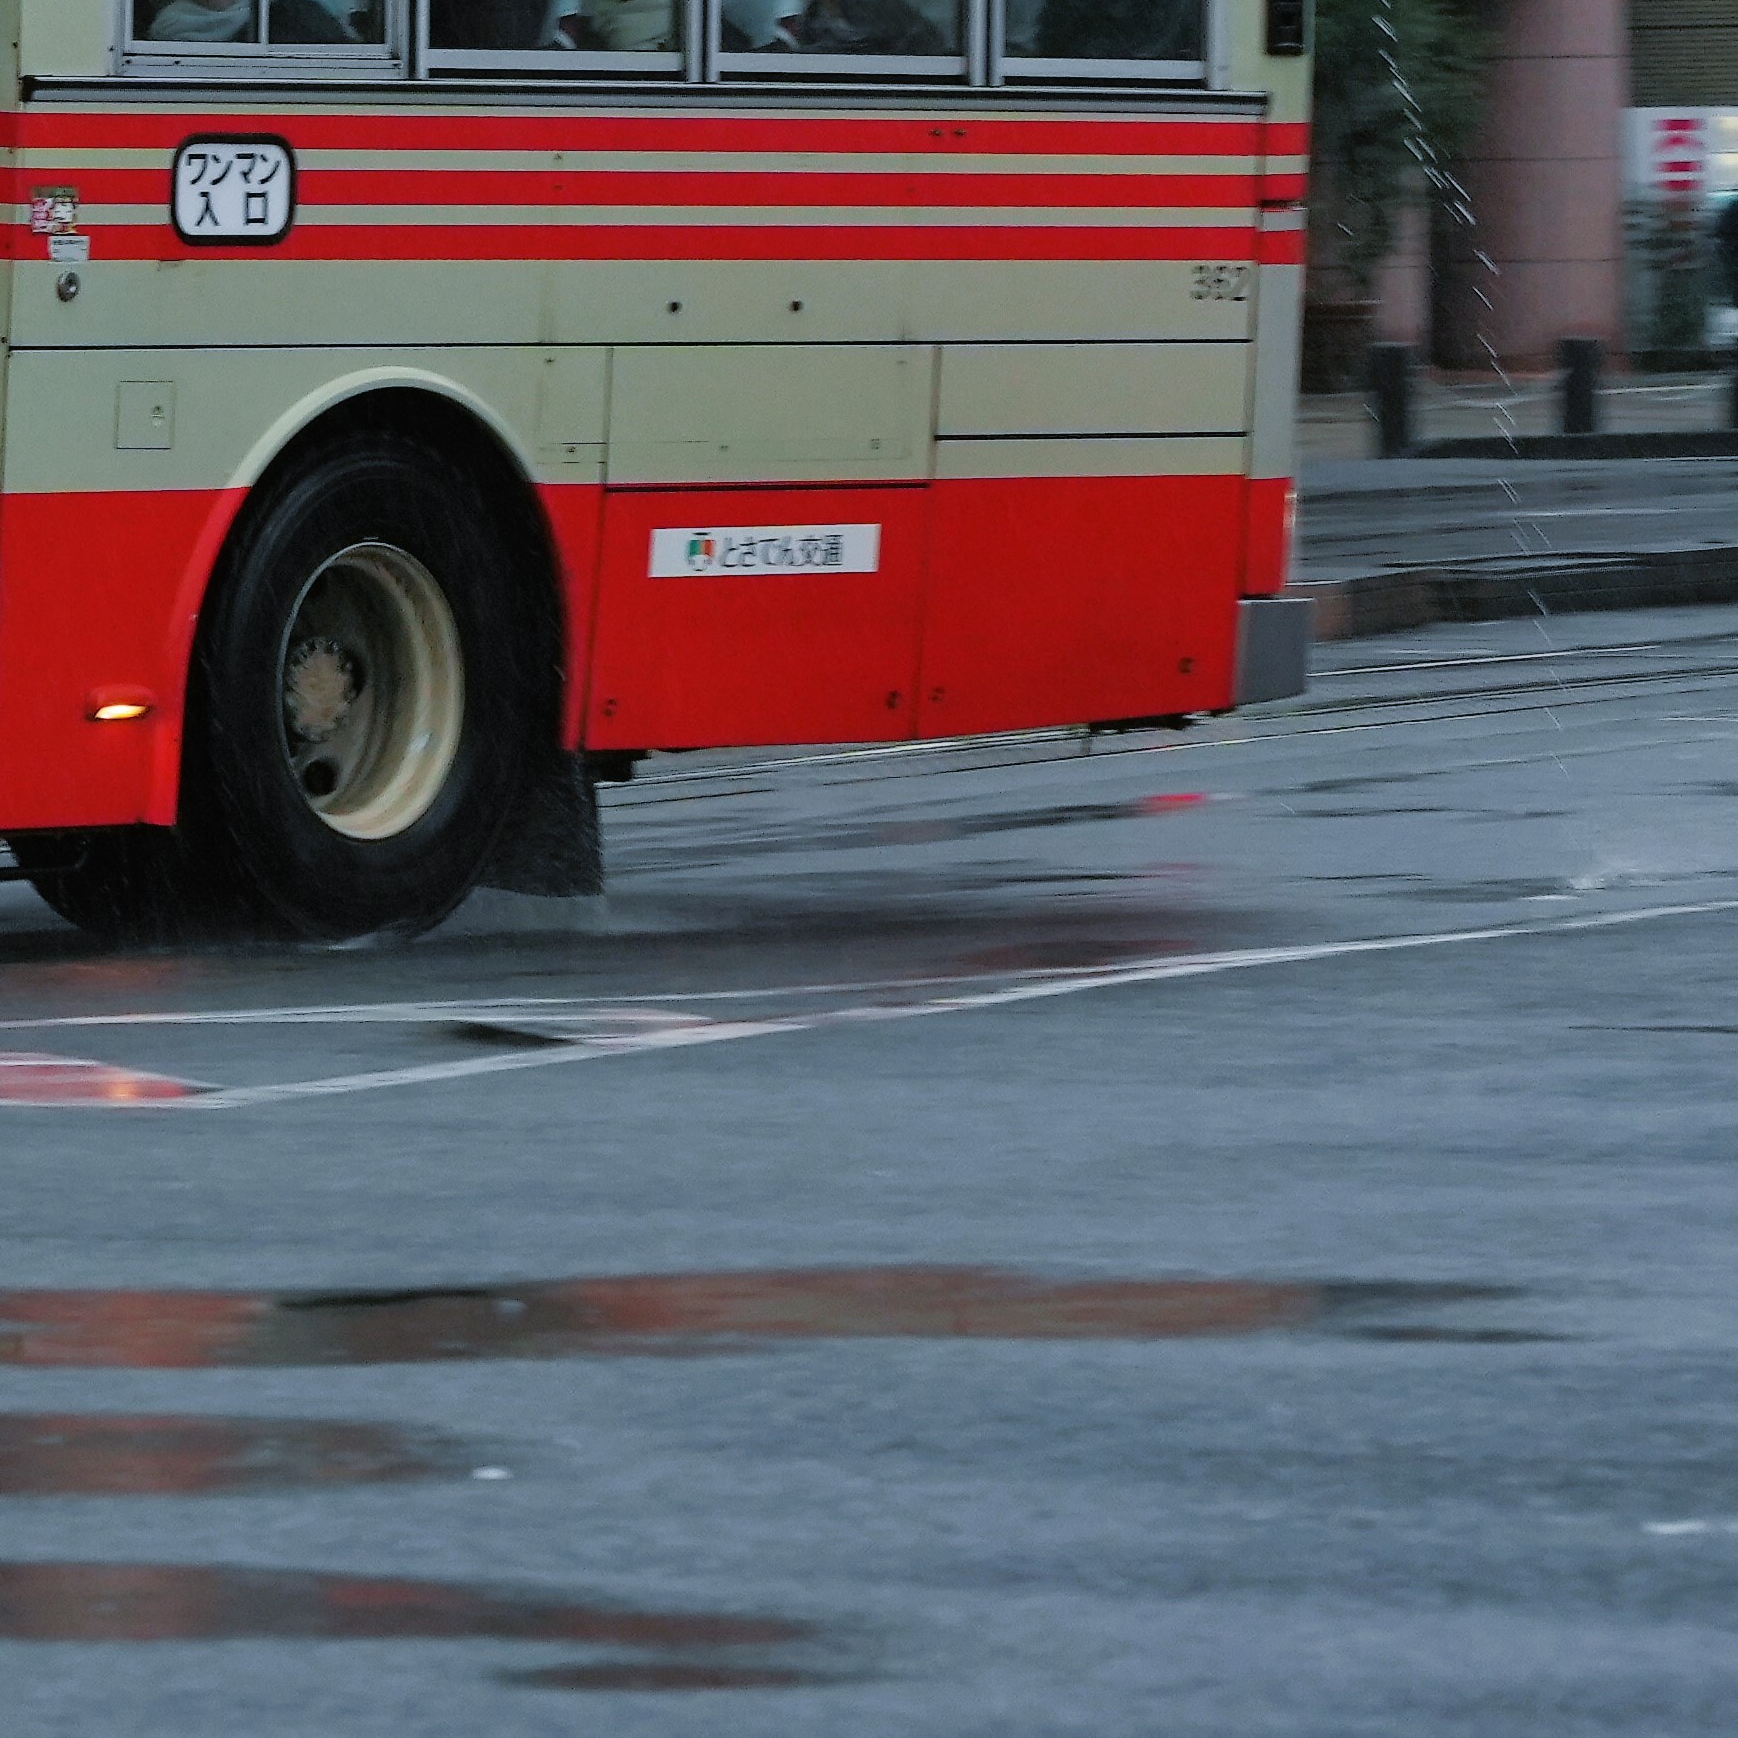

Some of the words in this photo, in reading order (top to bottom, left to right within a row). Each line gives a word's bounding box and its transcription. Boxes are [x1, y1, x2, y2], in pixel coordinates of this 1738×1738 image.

[187, 153, 281, 186] ワンマン
[194, 191, 269, 227] 入口
